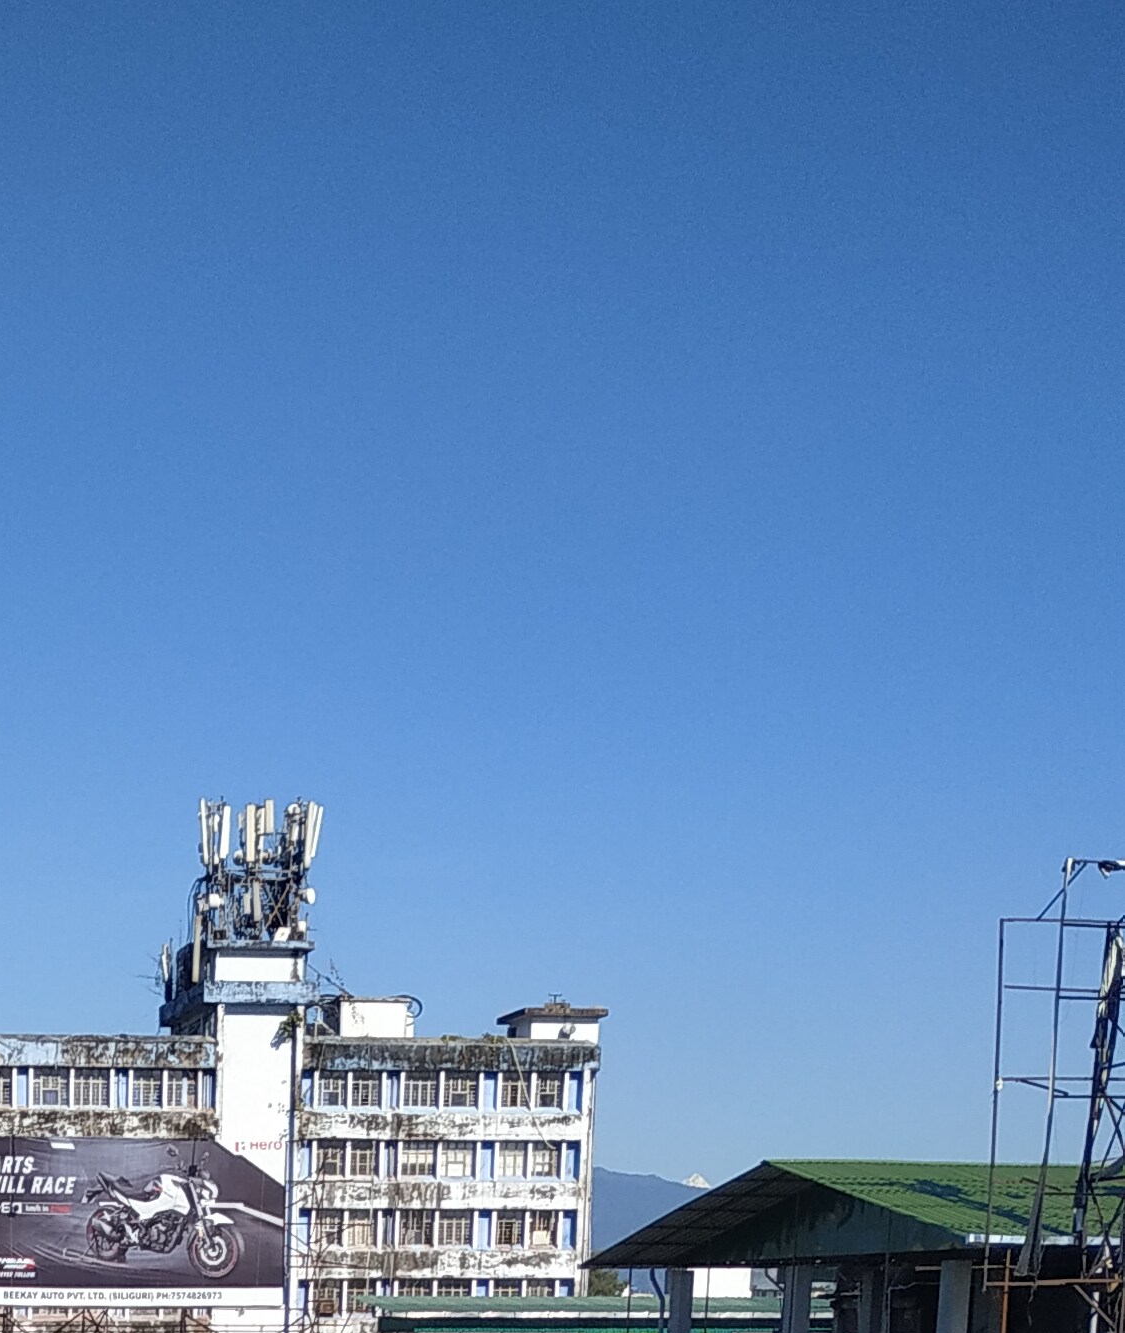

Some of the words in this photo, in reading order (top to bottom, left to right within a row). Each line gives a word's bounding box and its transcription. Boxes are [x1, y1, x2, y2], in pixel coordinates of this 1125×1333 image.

[250, 1141, 282, 1150] Hero
[30, 1176, 76, 1195] RACE
[3, 1291, 38, 1300] BEEKAY
[40, 1291, 64, 1300] AUTO
[66, 1291, 85, 1300] PVT.
[87, 1291, 107, 1300] LTD.
